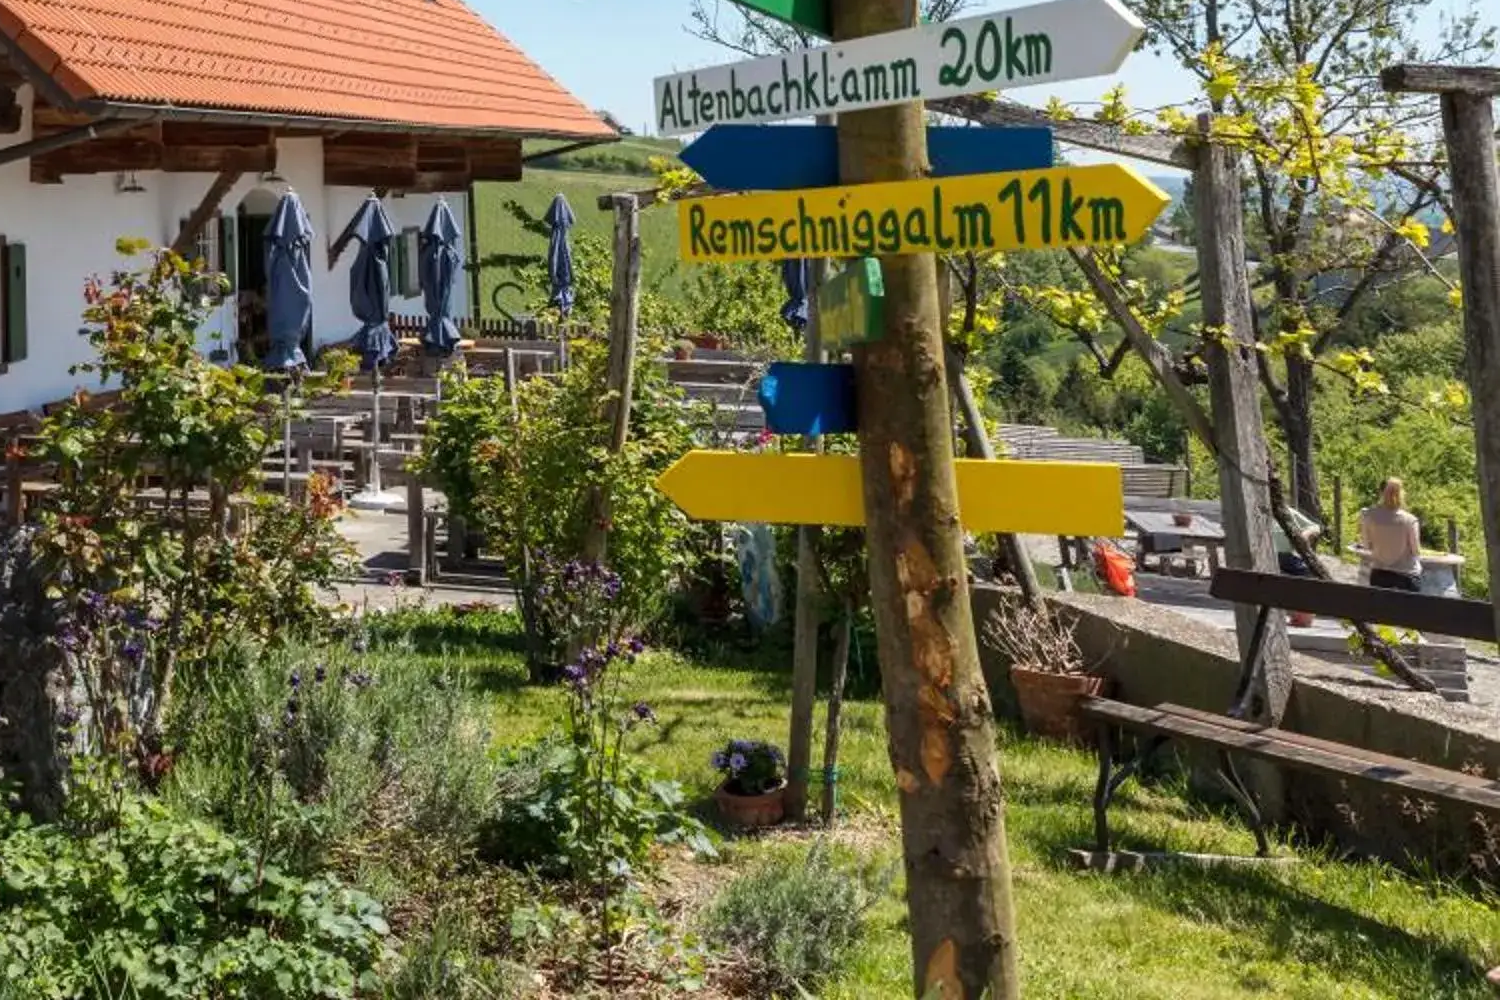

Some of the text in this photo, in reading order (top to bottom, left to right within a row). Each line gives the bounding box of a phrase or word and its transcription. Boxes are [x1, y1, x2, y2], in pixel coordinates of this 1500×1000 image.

[659, 17, 1053, 130] Altenbachklamm 20km
[690, 177, 1127, 256] Remschniggalm 11km
